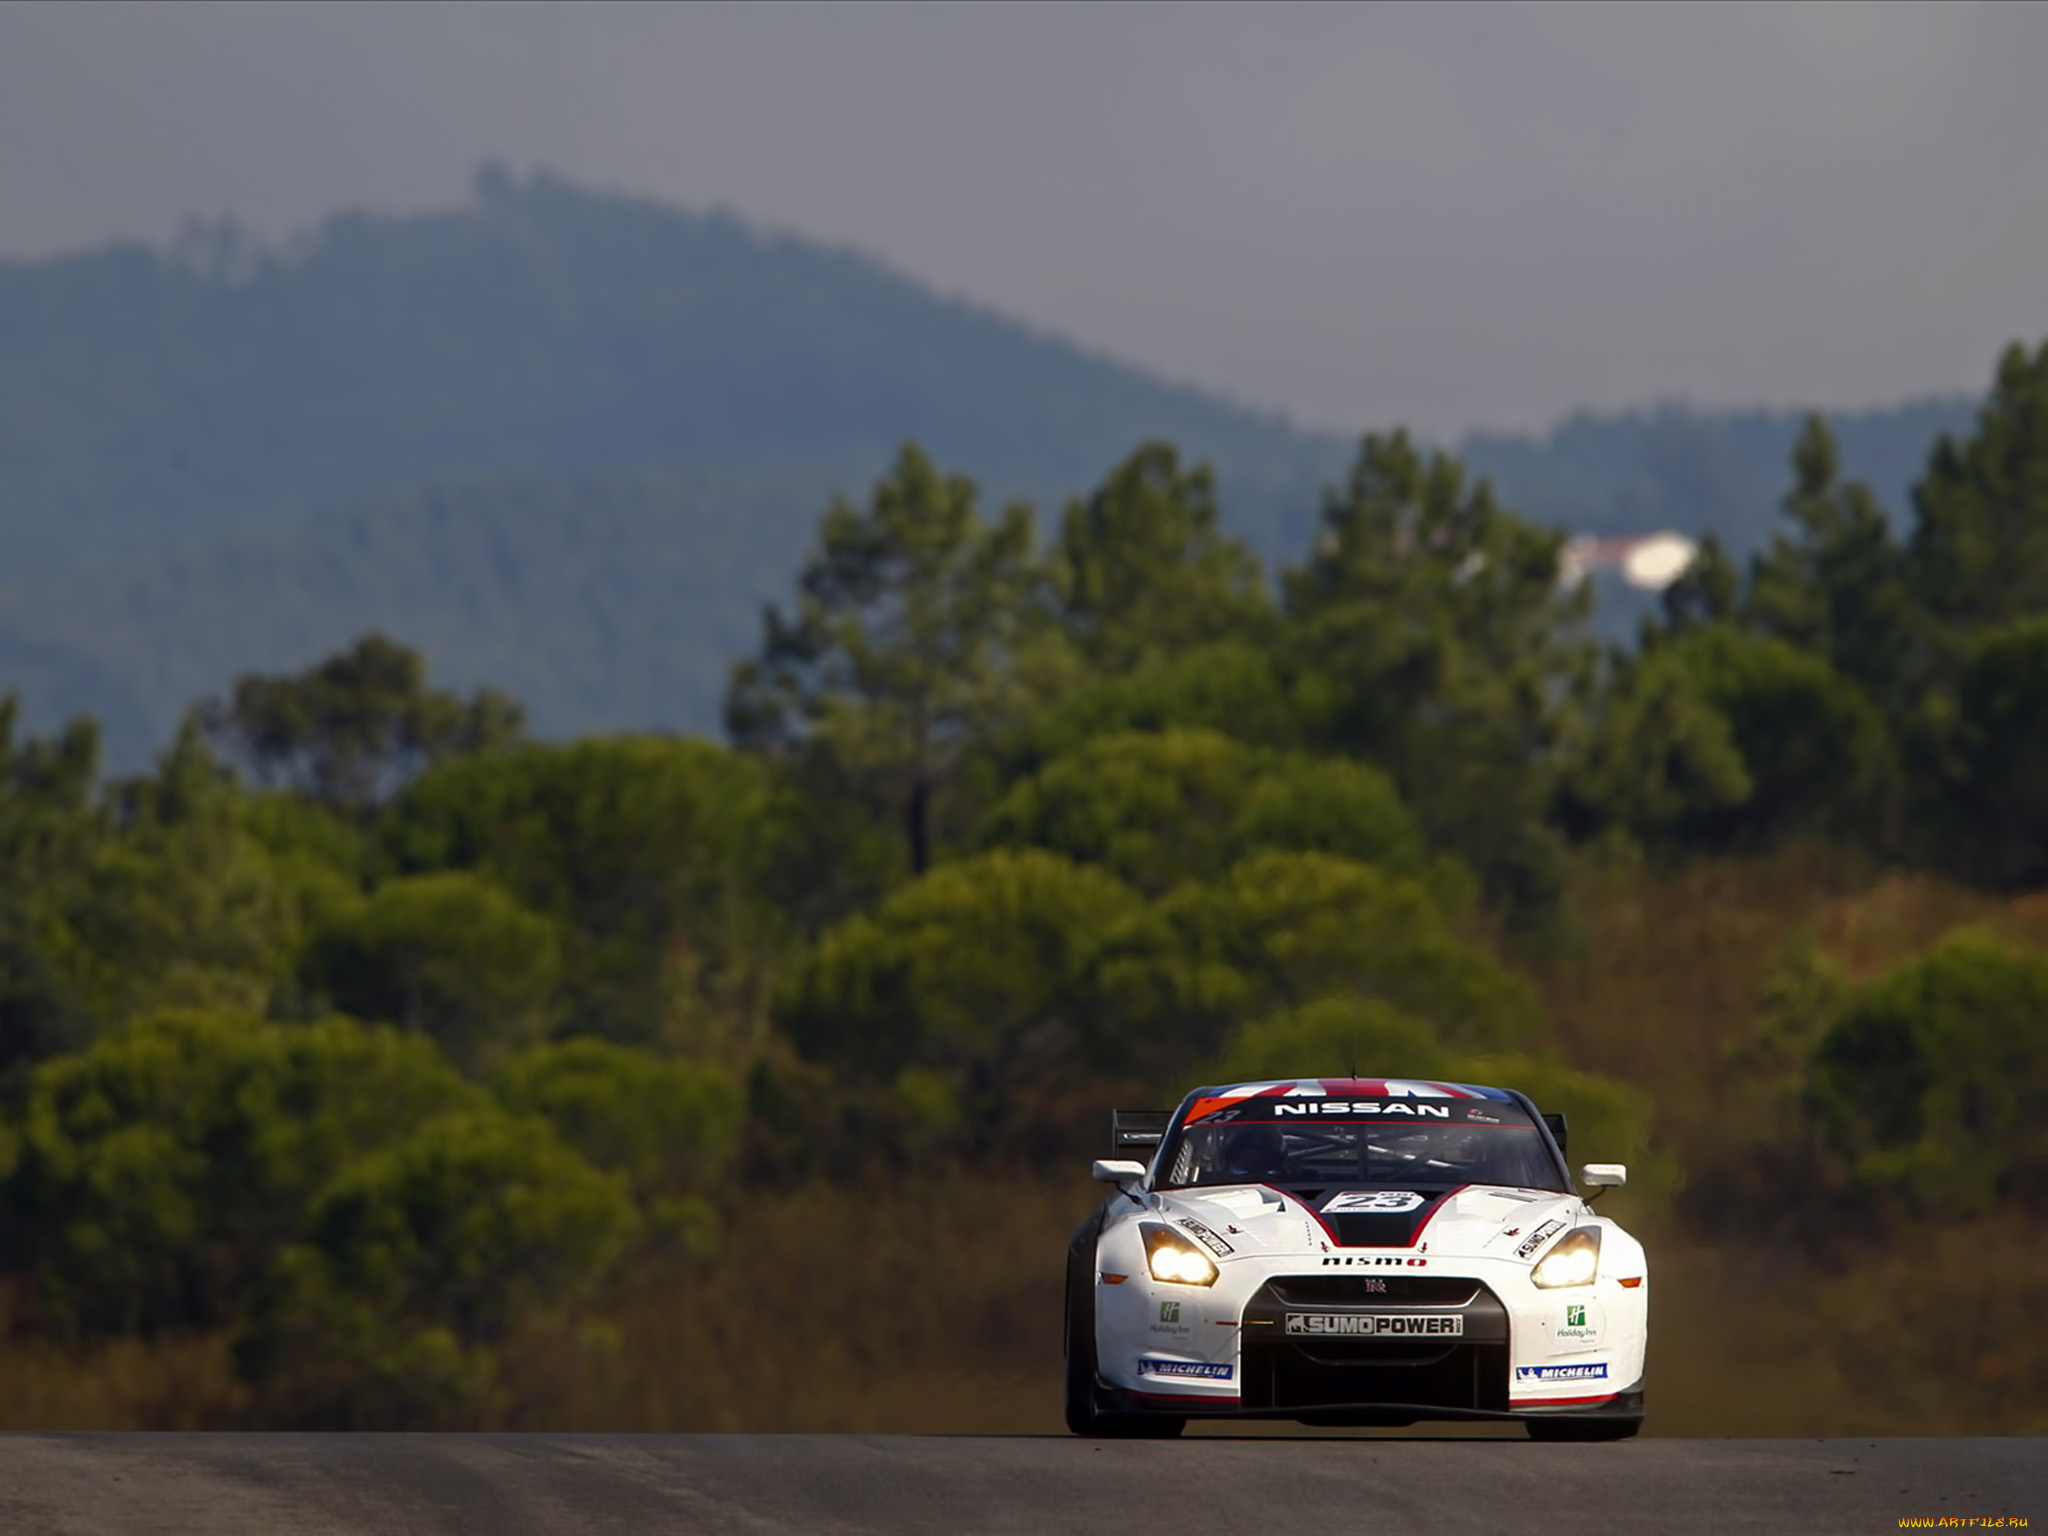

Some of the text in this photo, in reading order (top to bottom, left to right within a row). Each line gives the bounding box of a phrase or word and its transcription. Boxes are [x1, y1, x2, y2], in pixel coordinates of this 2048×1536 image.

[1274, 1102, 1449, 1118] NISSAN
[1194, 1110, 1241, 1124] 23
[1337, 1196, 1413, 1208] 23
[1322, 1257, 1427, 1266] nismo
[1557, 1328, 1597, 1338] Holiday Inn
[1159, 1363, 1229, 1375] MICHELIN
[1541, 1366, 1604, 1378] MICHELIN
